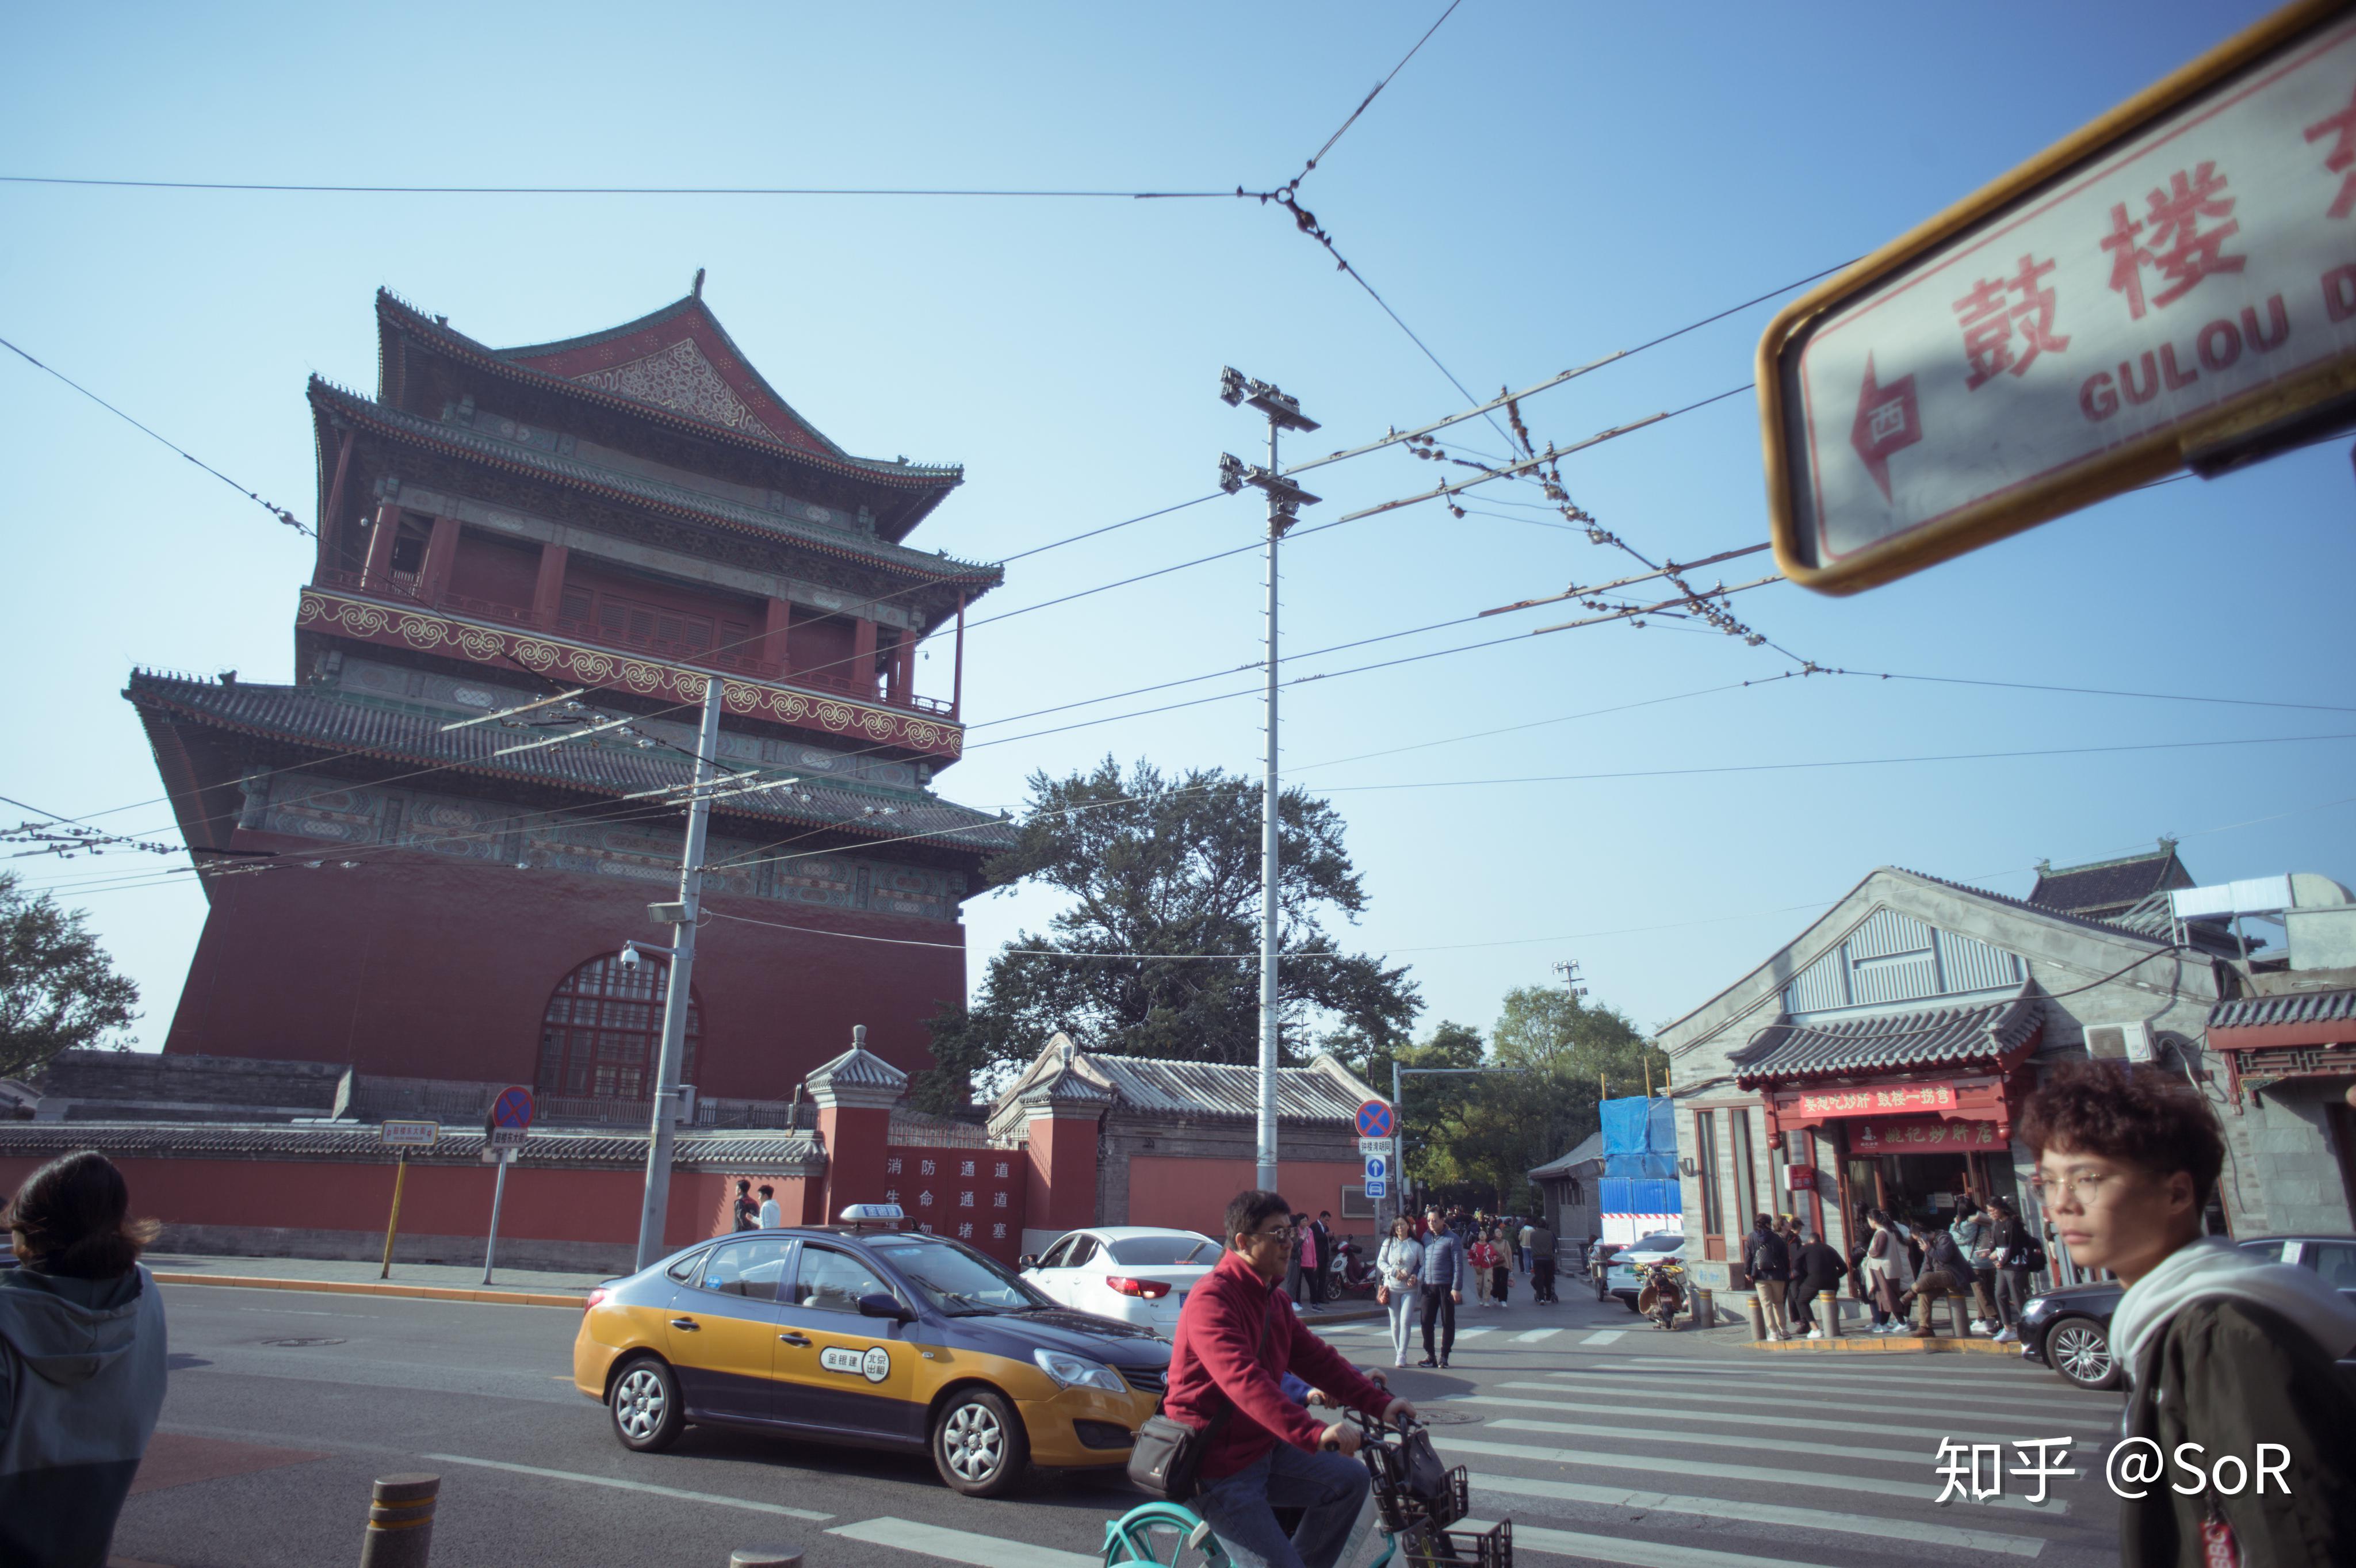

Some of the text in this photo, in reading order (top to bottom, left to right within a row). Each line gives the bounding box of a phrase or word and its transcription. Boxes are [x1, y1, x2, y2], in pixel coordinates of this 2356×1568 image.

[2079, 294, 2290, 423] GULOU
[1868, 397, 1905, 444] 西
[1804, 1086, 1949, 1112] 要想吃炒肝 鼓楼一拐弯
[1884, 1121, 1993, 1144] 姚记炒肝店
[1361, 1141, 1390, 1152] 钟楼湾胡同
[888, 1158, 1009, 1178] 消防通道
[886, 1189, 1008, 1207] 生命通道
[828, 1353, 858, 1367] 金银建
[868, 1353, 886, 1365] 北京
[867, 1364, 885, 1375] 出租
